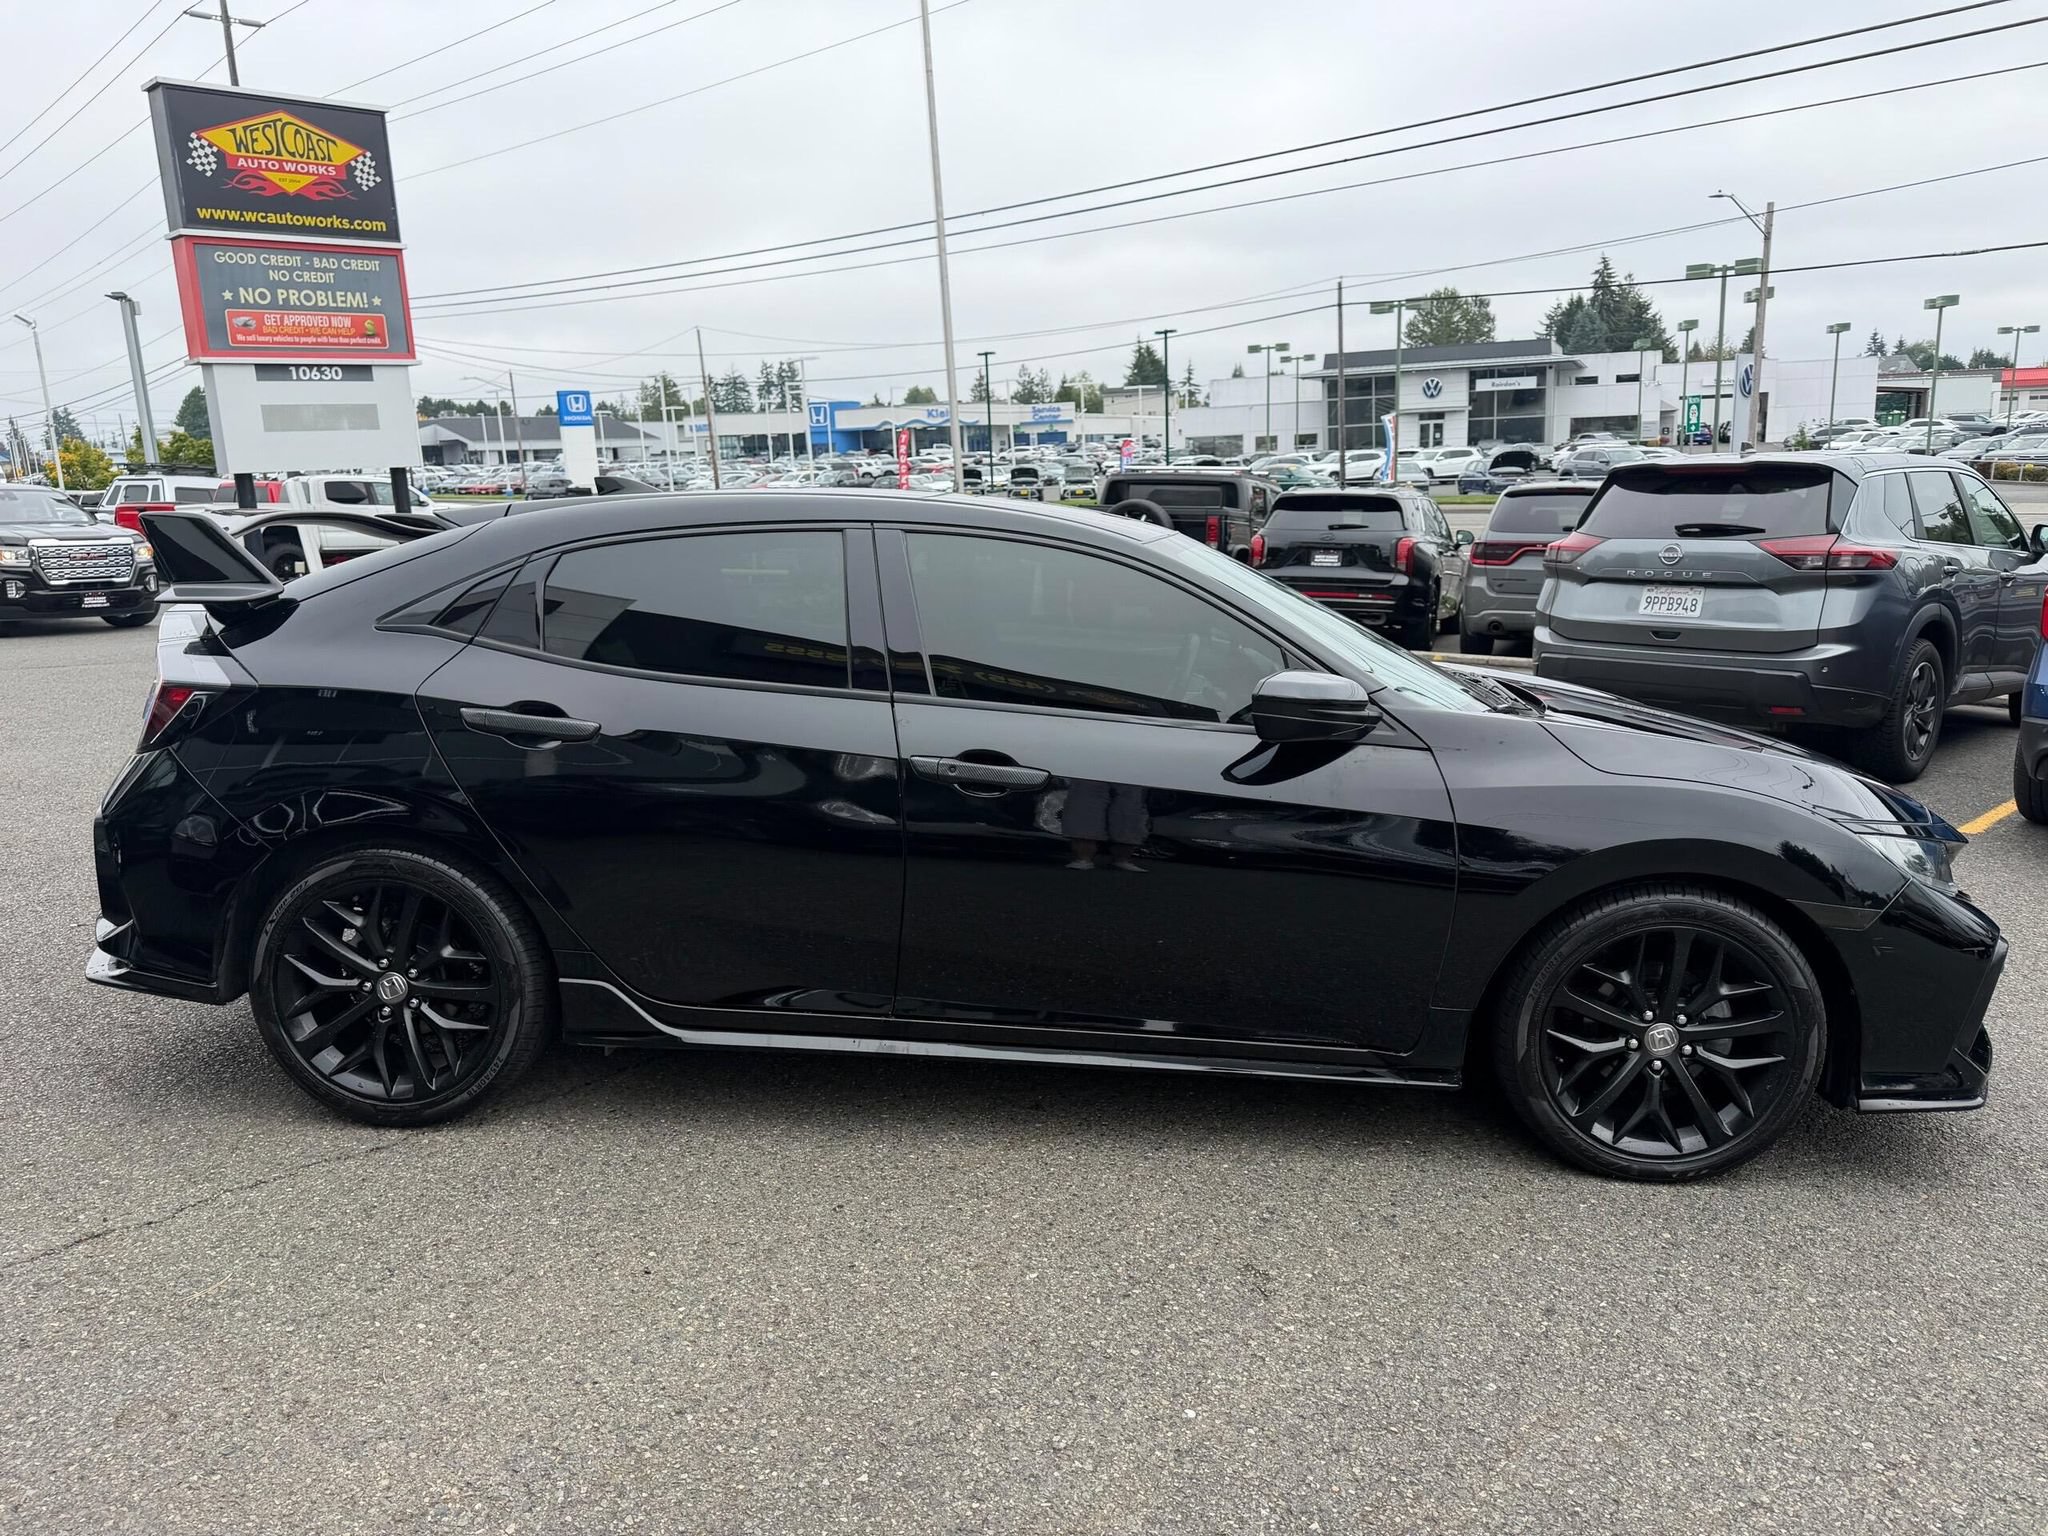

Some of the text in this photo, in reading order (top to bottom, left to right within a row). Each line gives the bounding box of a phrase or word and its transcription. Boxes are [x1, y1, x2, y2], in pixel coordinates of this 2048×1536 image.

[237, 157, 337, 176] AUTO WORKS
[197, 207, 387, 232] www.wcautoworks.com
[214, 251, 257, 265] GOOD
[260, 254, 302, 267] CREDIT
[313, 257, 338, 270] BAD
[341, 259, 380, 272] CREDIT
[269, 270, 335, 284] NO CREDIT
[238, 287, 368, 308] NO PROBLEM!
[264, 314, 352, 328] GET APPROVED NOW
[263, 326, 279, 334] BAD
[280, 326, 304, 335] CREDIT
[323, 327, 338, 335] CAN
[288, 366, 343, 381] 10630
[927, 408, 949, 418] Klei
[1627, 570, 1712, 578] ROGUE
[1643, 596, 1698, 613] 9PPB948
